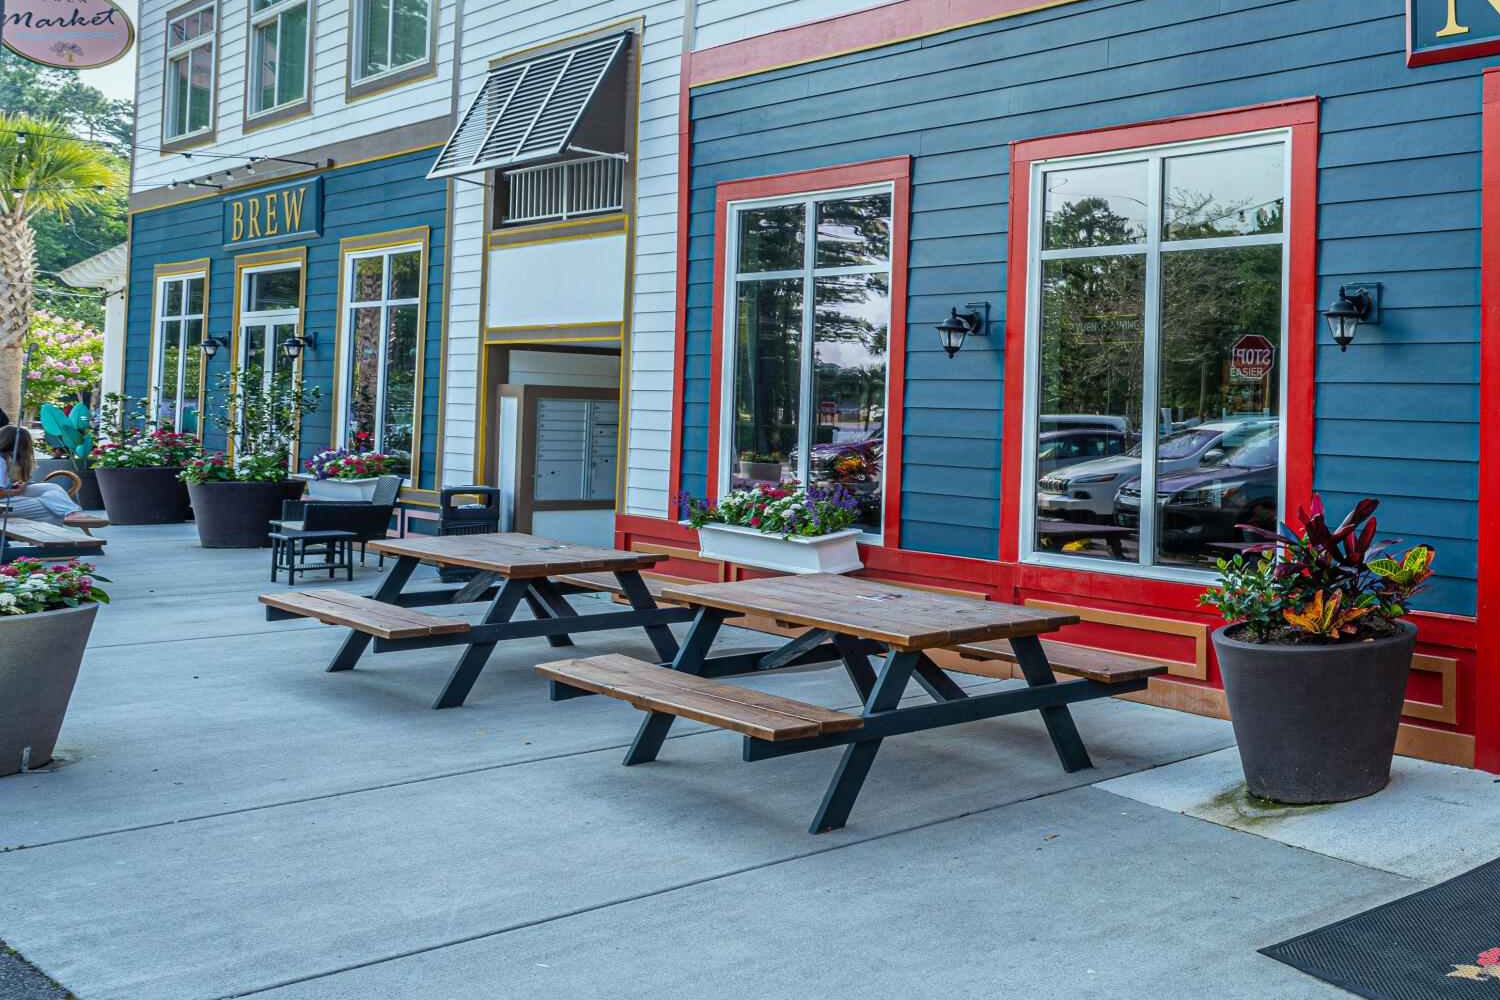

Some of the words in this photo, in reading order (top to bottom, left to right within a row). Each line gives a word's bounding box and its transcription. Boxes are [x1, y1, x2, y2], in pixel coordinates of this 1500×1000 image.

[3, 7, 119, 28] Market
[231, 187, 307, 241] BREW
[1230, 367, 1263, 377] EASIER
